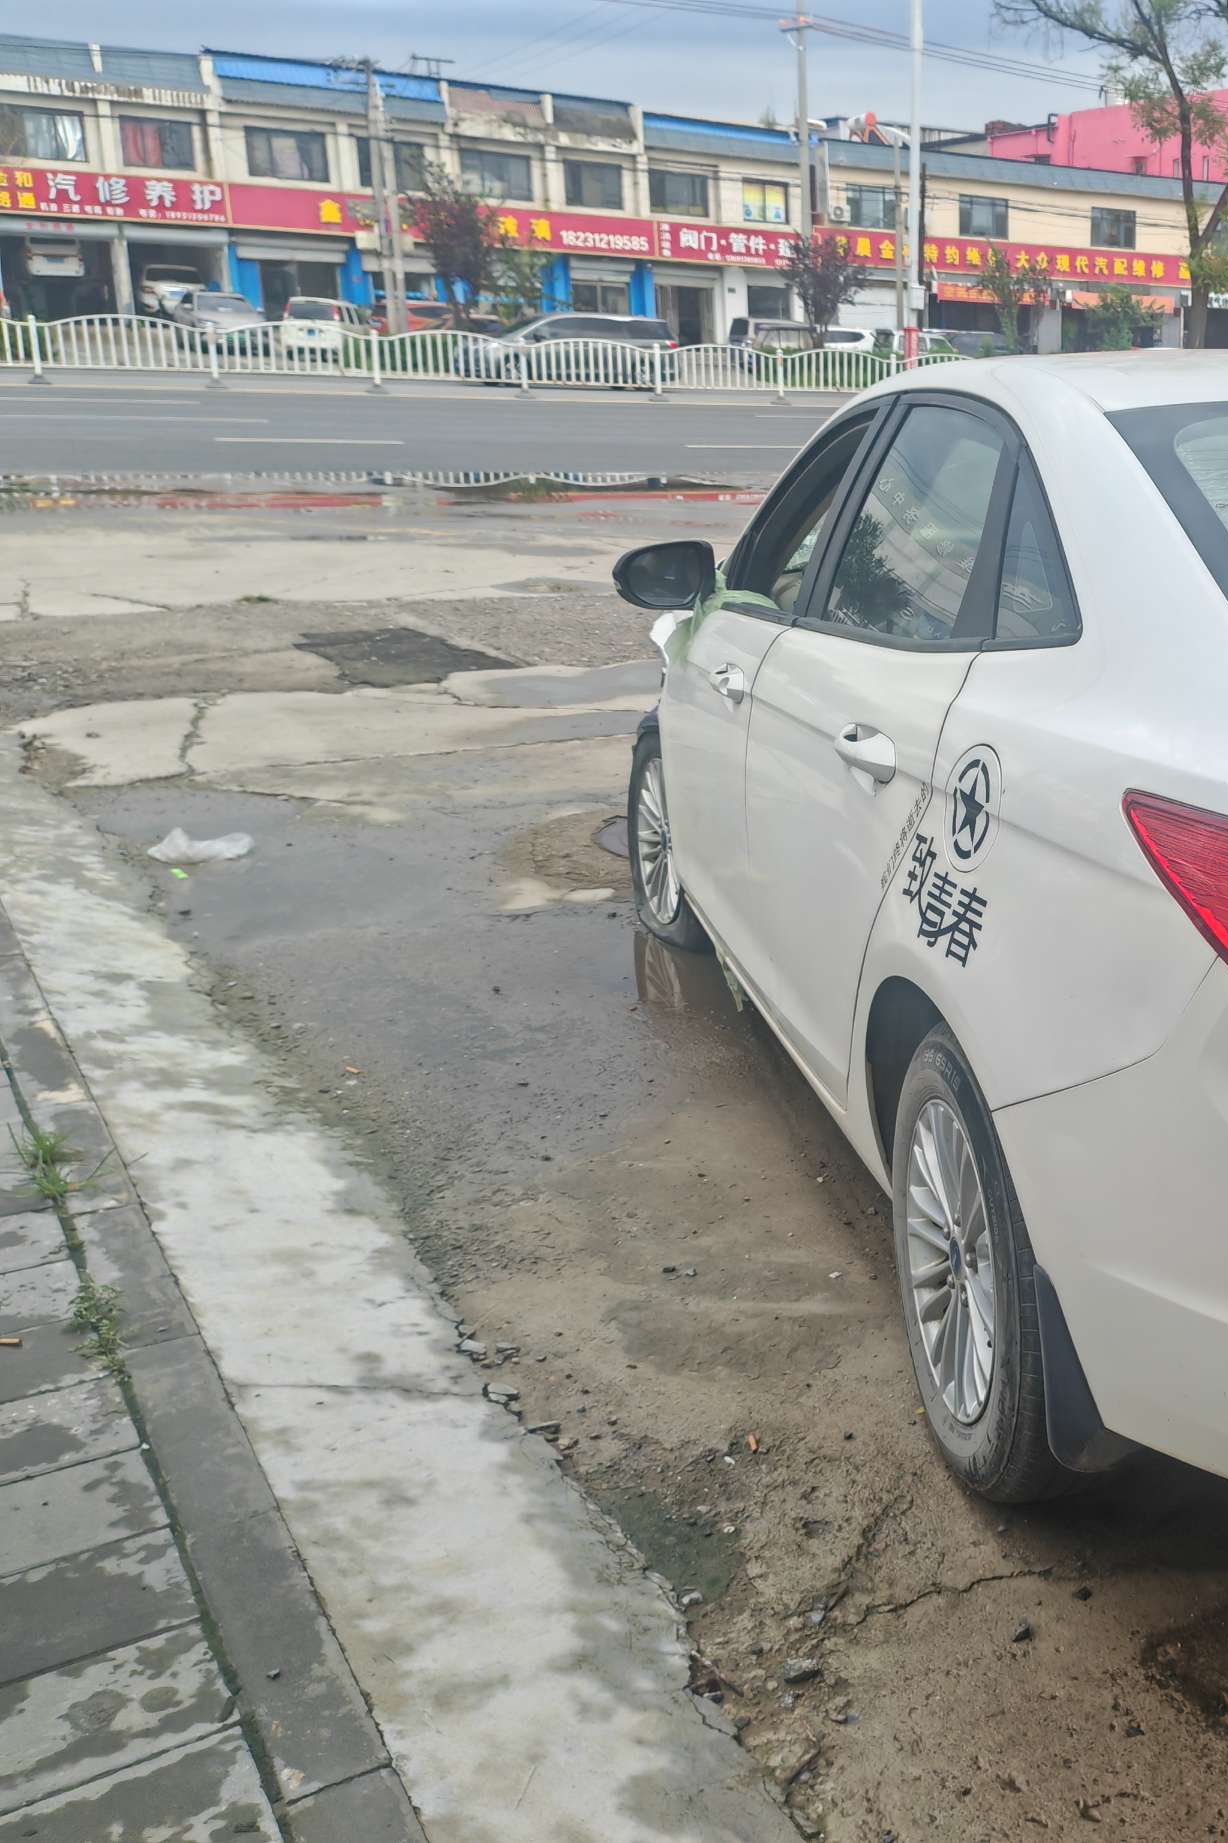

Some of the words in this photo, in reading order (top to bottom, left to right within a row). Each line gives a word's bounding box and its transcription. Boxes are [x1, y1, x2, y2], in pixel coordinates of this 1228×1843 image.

[46, 172, 222, 210] 汽修养护
[1016, 251, 1165, 278] 大众现代汽配维修
[902, 833, 987, 968] 致青春
